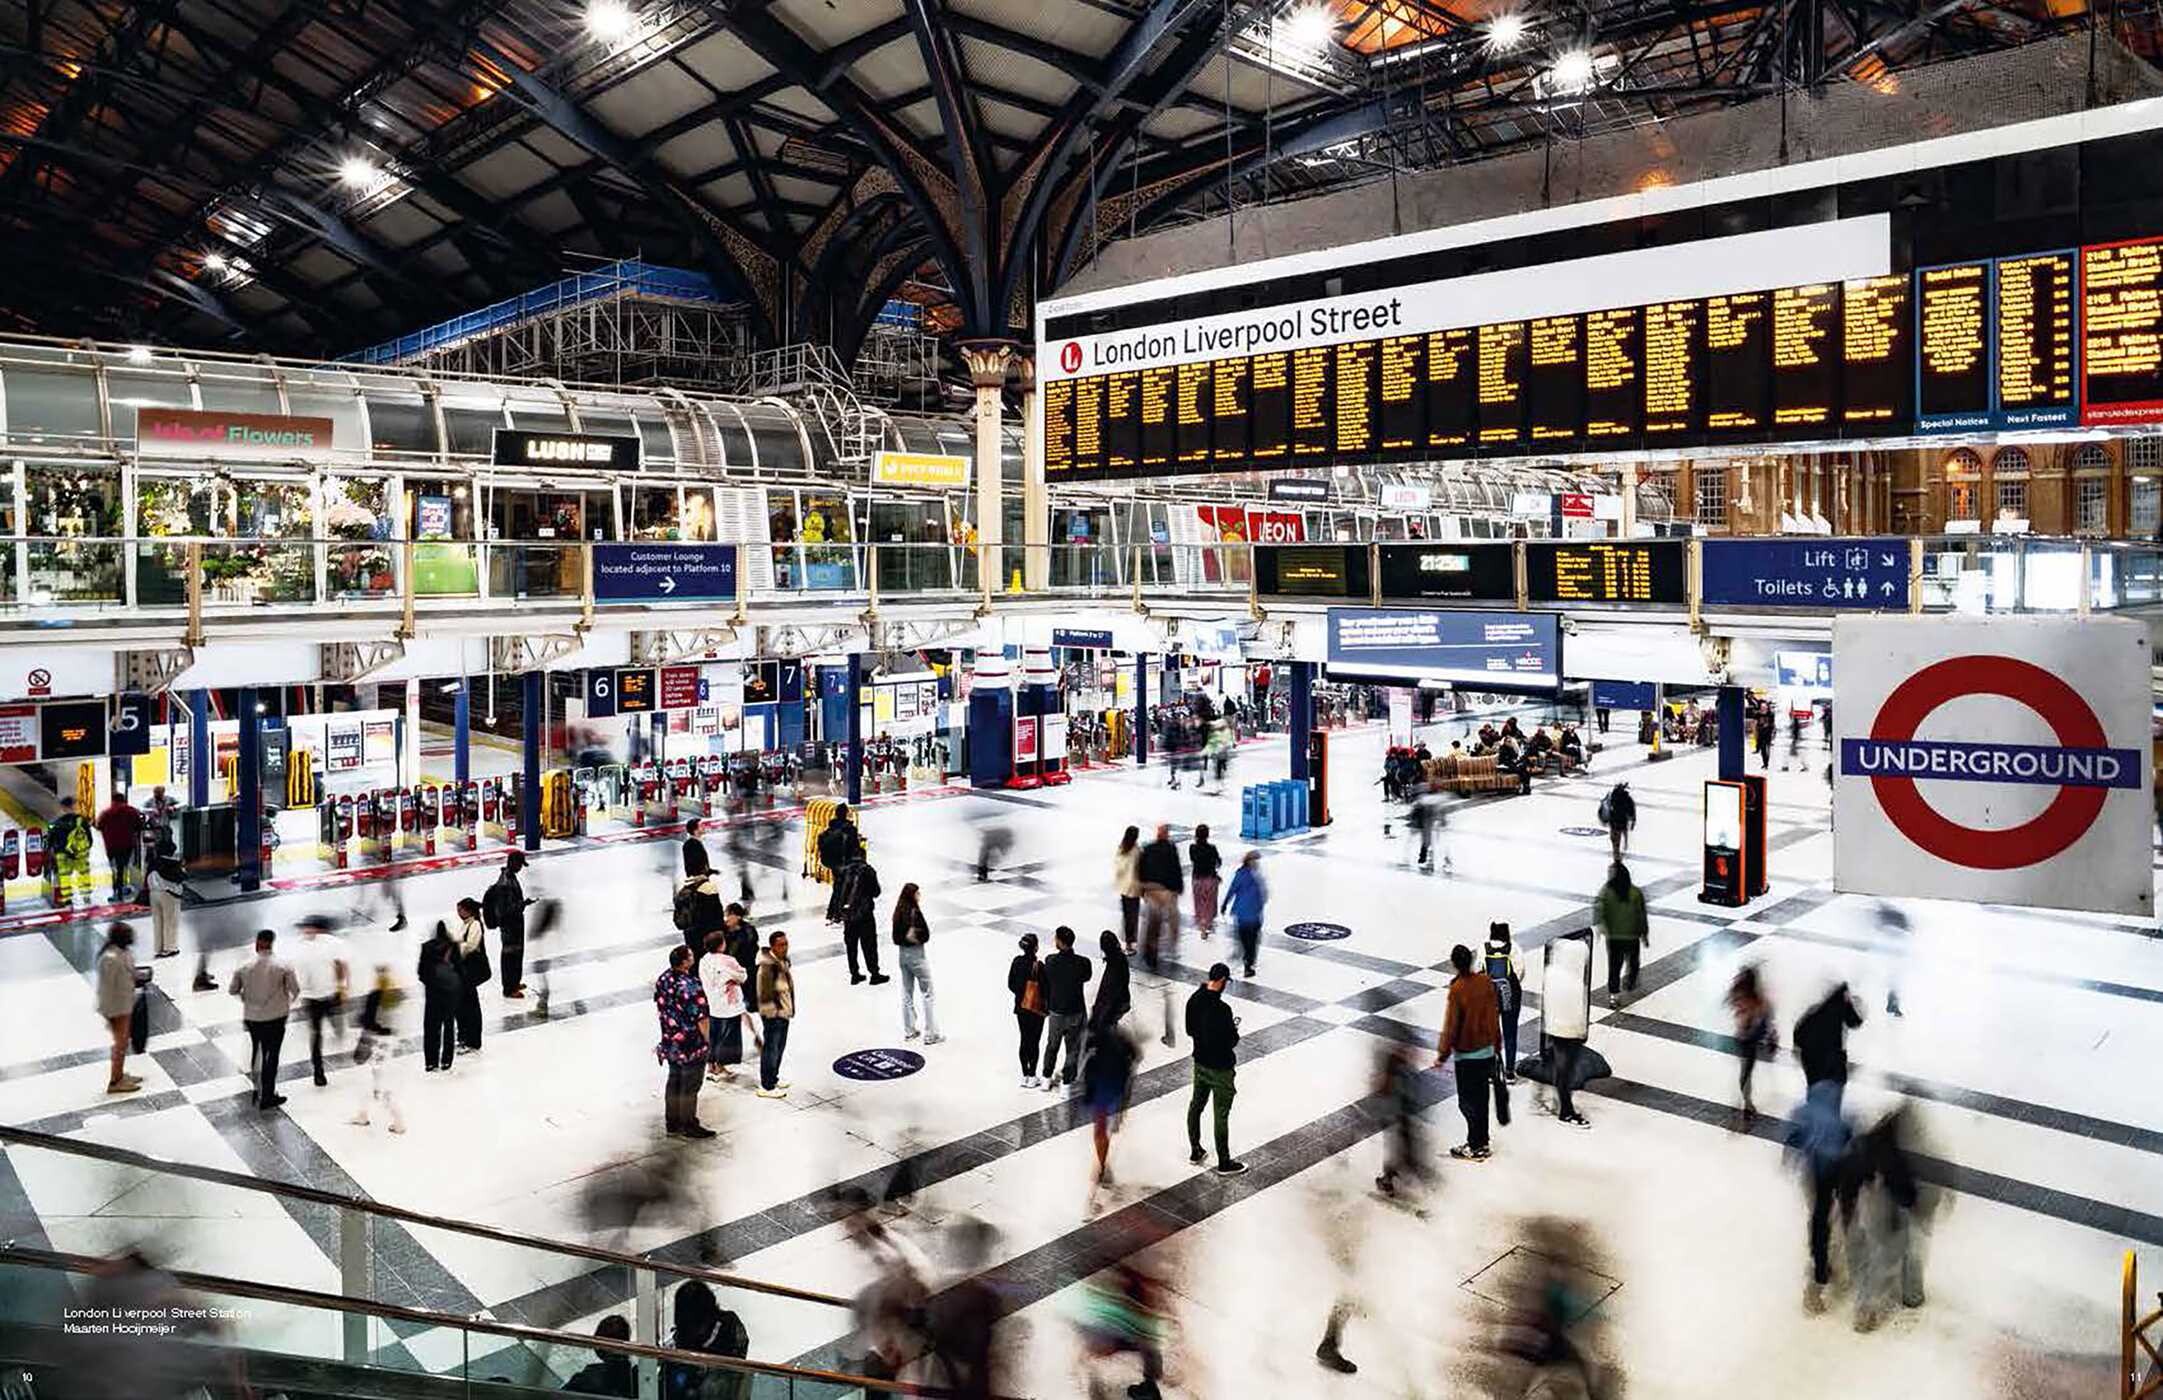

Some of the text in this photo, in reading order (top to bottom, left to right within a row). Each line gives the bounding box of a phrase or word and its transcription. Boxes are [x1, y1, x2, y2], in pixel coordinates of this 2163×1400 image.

[1094, 333, 1176, 366] London
[1184, 310, 1301, 353] Liverpool
[1310, 298, 1402, 336] Street
[1920, 417, 1988, 430] Special Notices
[2007, 413, 2067, 424] Next Fastest
[228, 426, 314, 446] Flowers
[1258, 522, 1297, 541] LEON
[631, 551, 704, 562] Customer Lounge
[1805, 550, 1836, 567] Lift
[601, 563, 731, 574] located adjacent to Platform 10
[1755, 578, 1813, 595] Toilets
[784, 665, 797, 685] 7
[829, 674, 836, 688] 7
[594, 677, 609, 697] 6
[700, 681, 706, 697] 6
[120, 706, 139, 731] 5
[1859, 745, 2121, 780] UNDERGROUND
